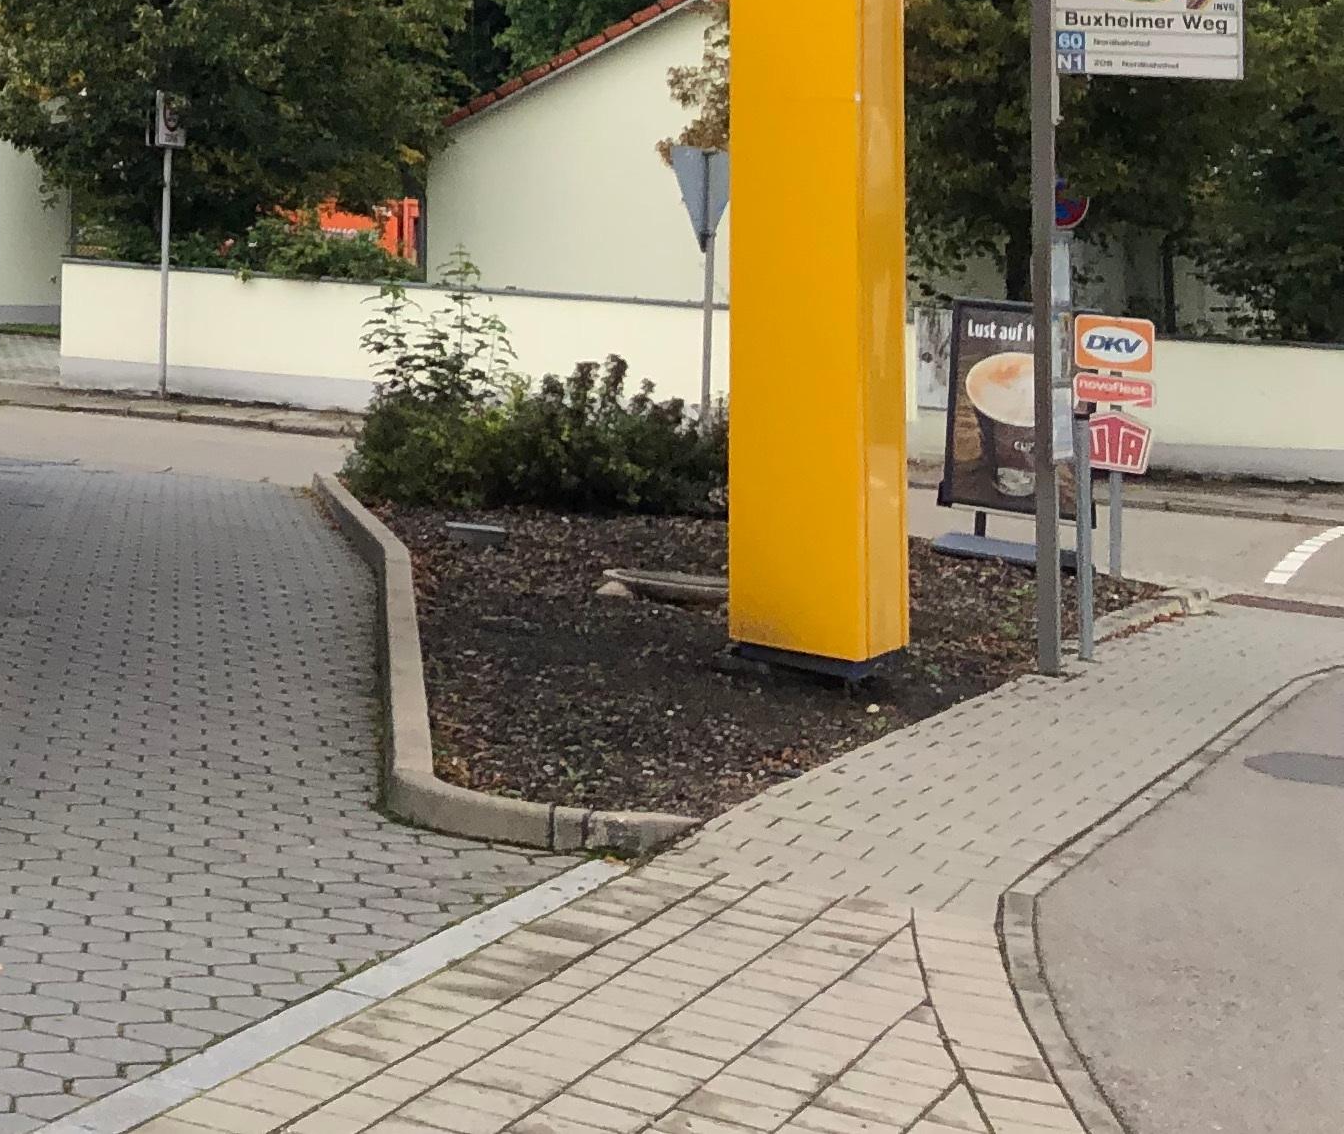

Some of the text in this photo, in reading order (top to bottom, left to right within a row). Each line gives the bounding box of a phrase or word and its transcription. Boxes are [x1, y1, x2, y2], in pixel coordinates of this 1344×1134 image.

[1064, 11, 1228, 35] Buxheimer Weg
[1058, 32, 1083, 49] 60
[1057, 53, 1083, 70] N1
[967, 318, 997, 341] Lust
[999, 322, 1024, 341] auf
[1085, 334, 1144, 354] DKV
